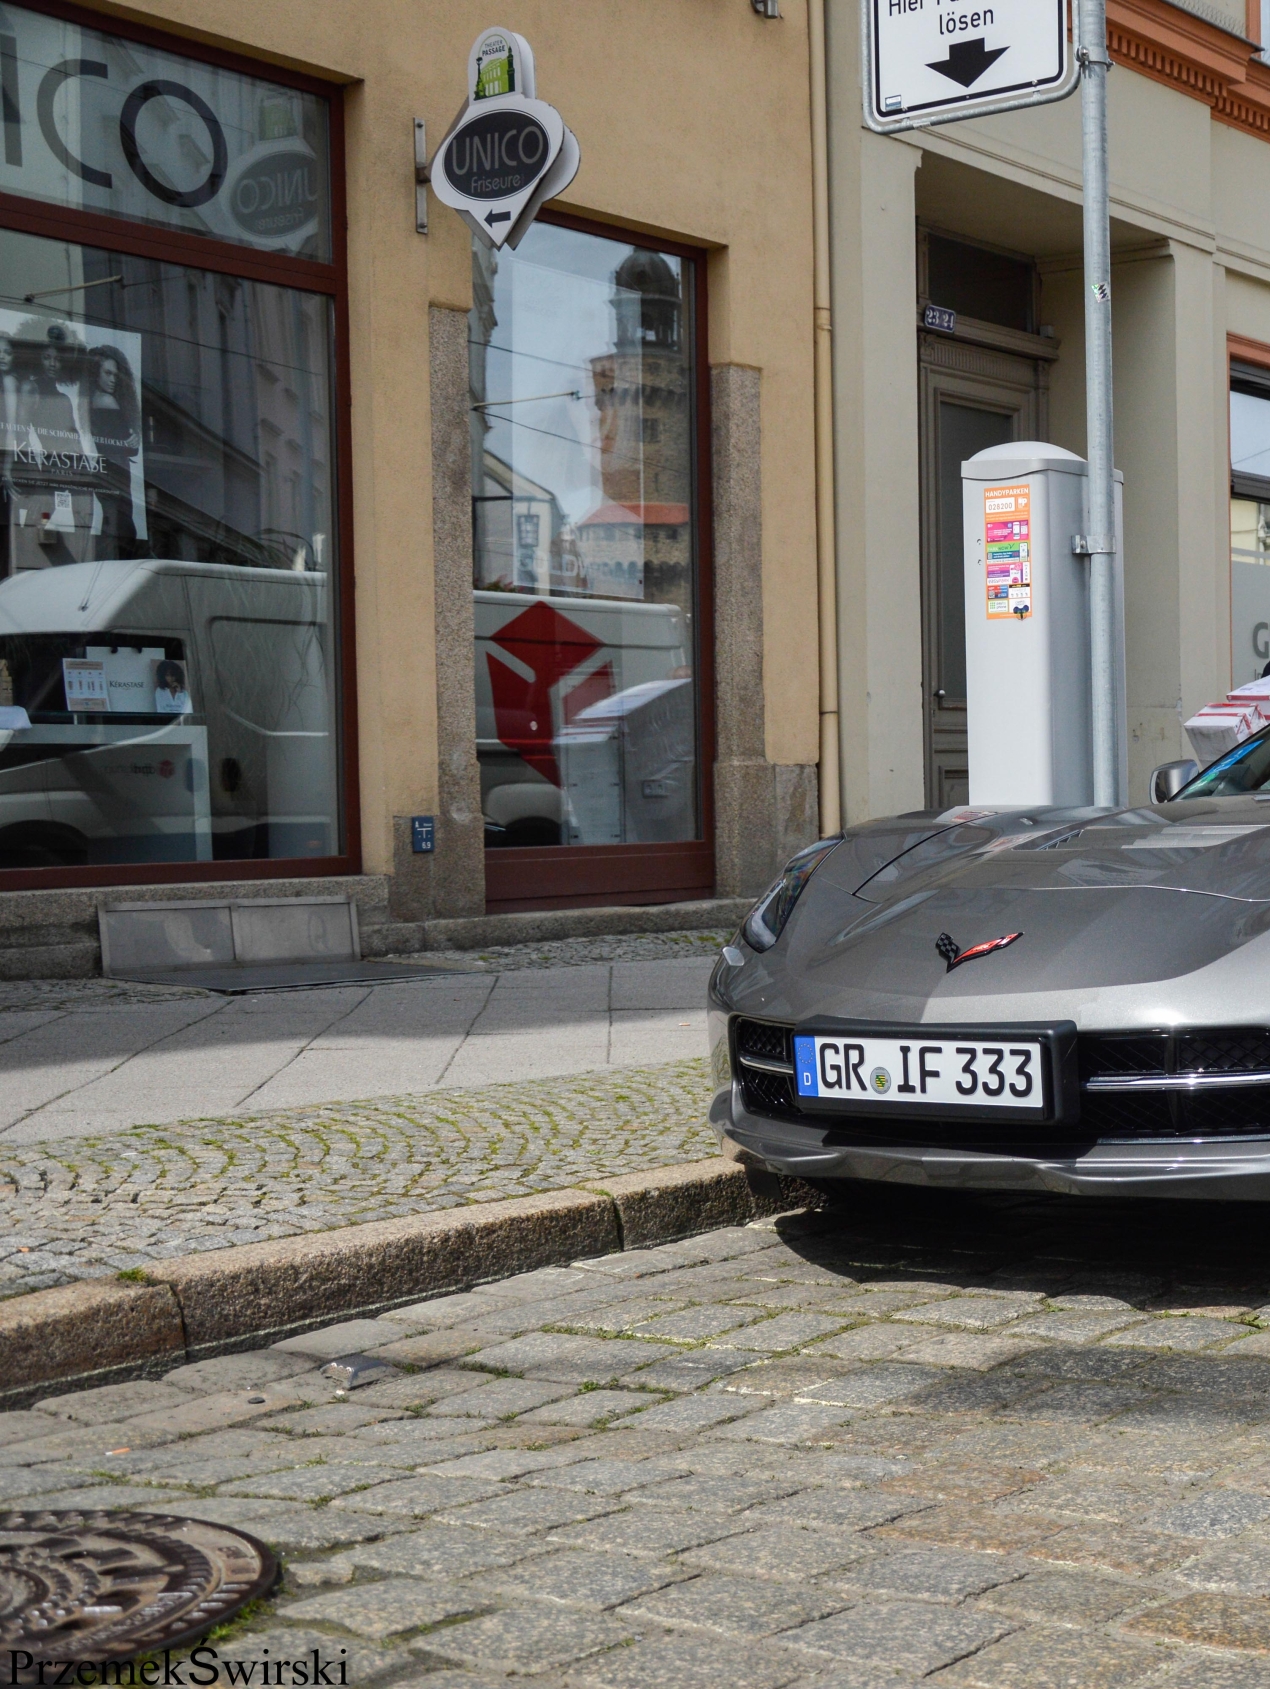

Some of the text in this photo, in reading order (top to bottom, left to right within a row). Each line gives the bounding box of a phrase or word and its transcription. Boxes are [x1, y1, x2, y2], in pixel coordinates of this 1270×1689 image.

[939, 8, 994, 35] lösen
[484, 39, 503, 48] THEATER
[481, 45, 506, 57] PASSAGE
[452, 125, 544, 175] UNICO
[51, 468, 73, 477] PARIS
[985, 487, 1029, 498] HANDYPARKEN
[988, 502, 1013, 511] 028200
[803, 1042, 1033, 1098] D GR IF 333
